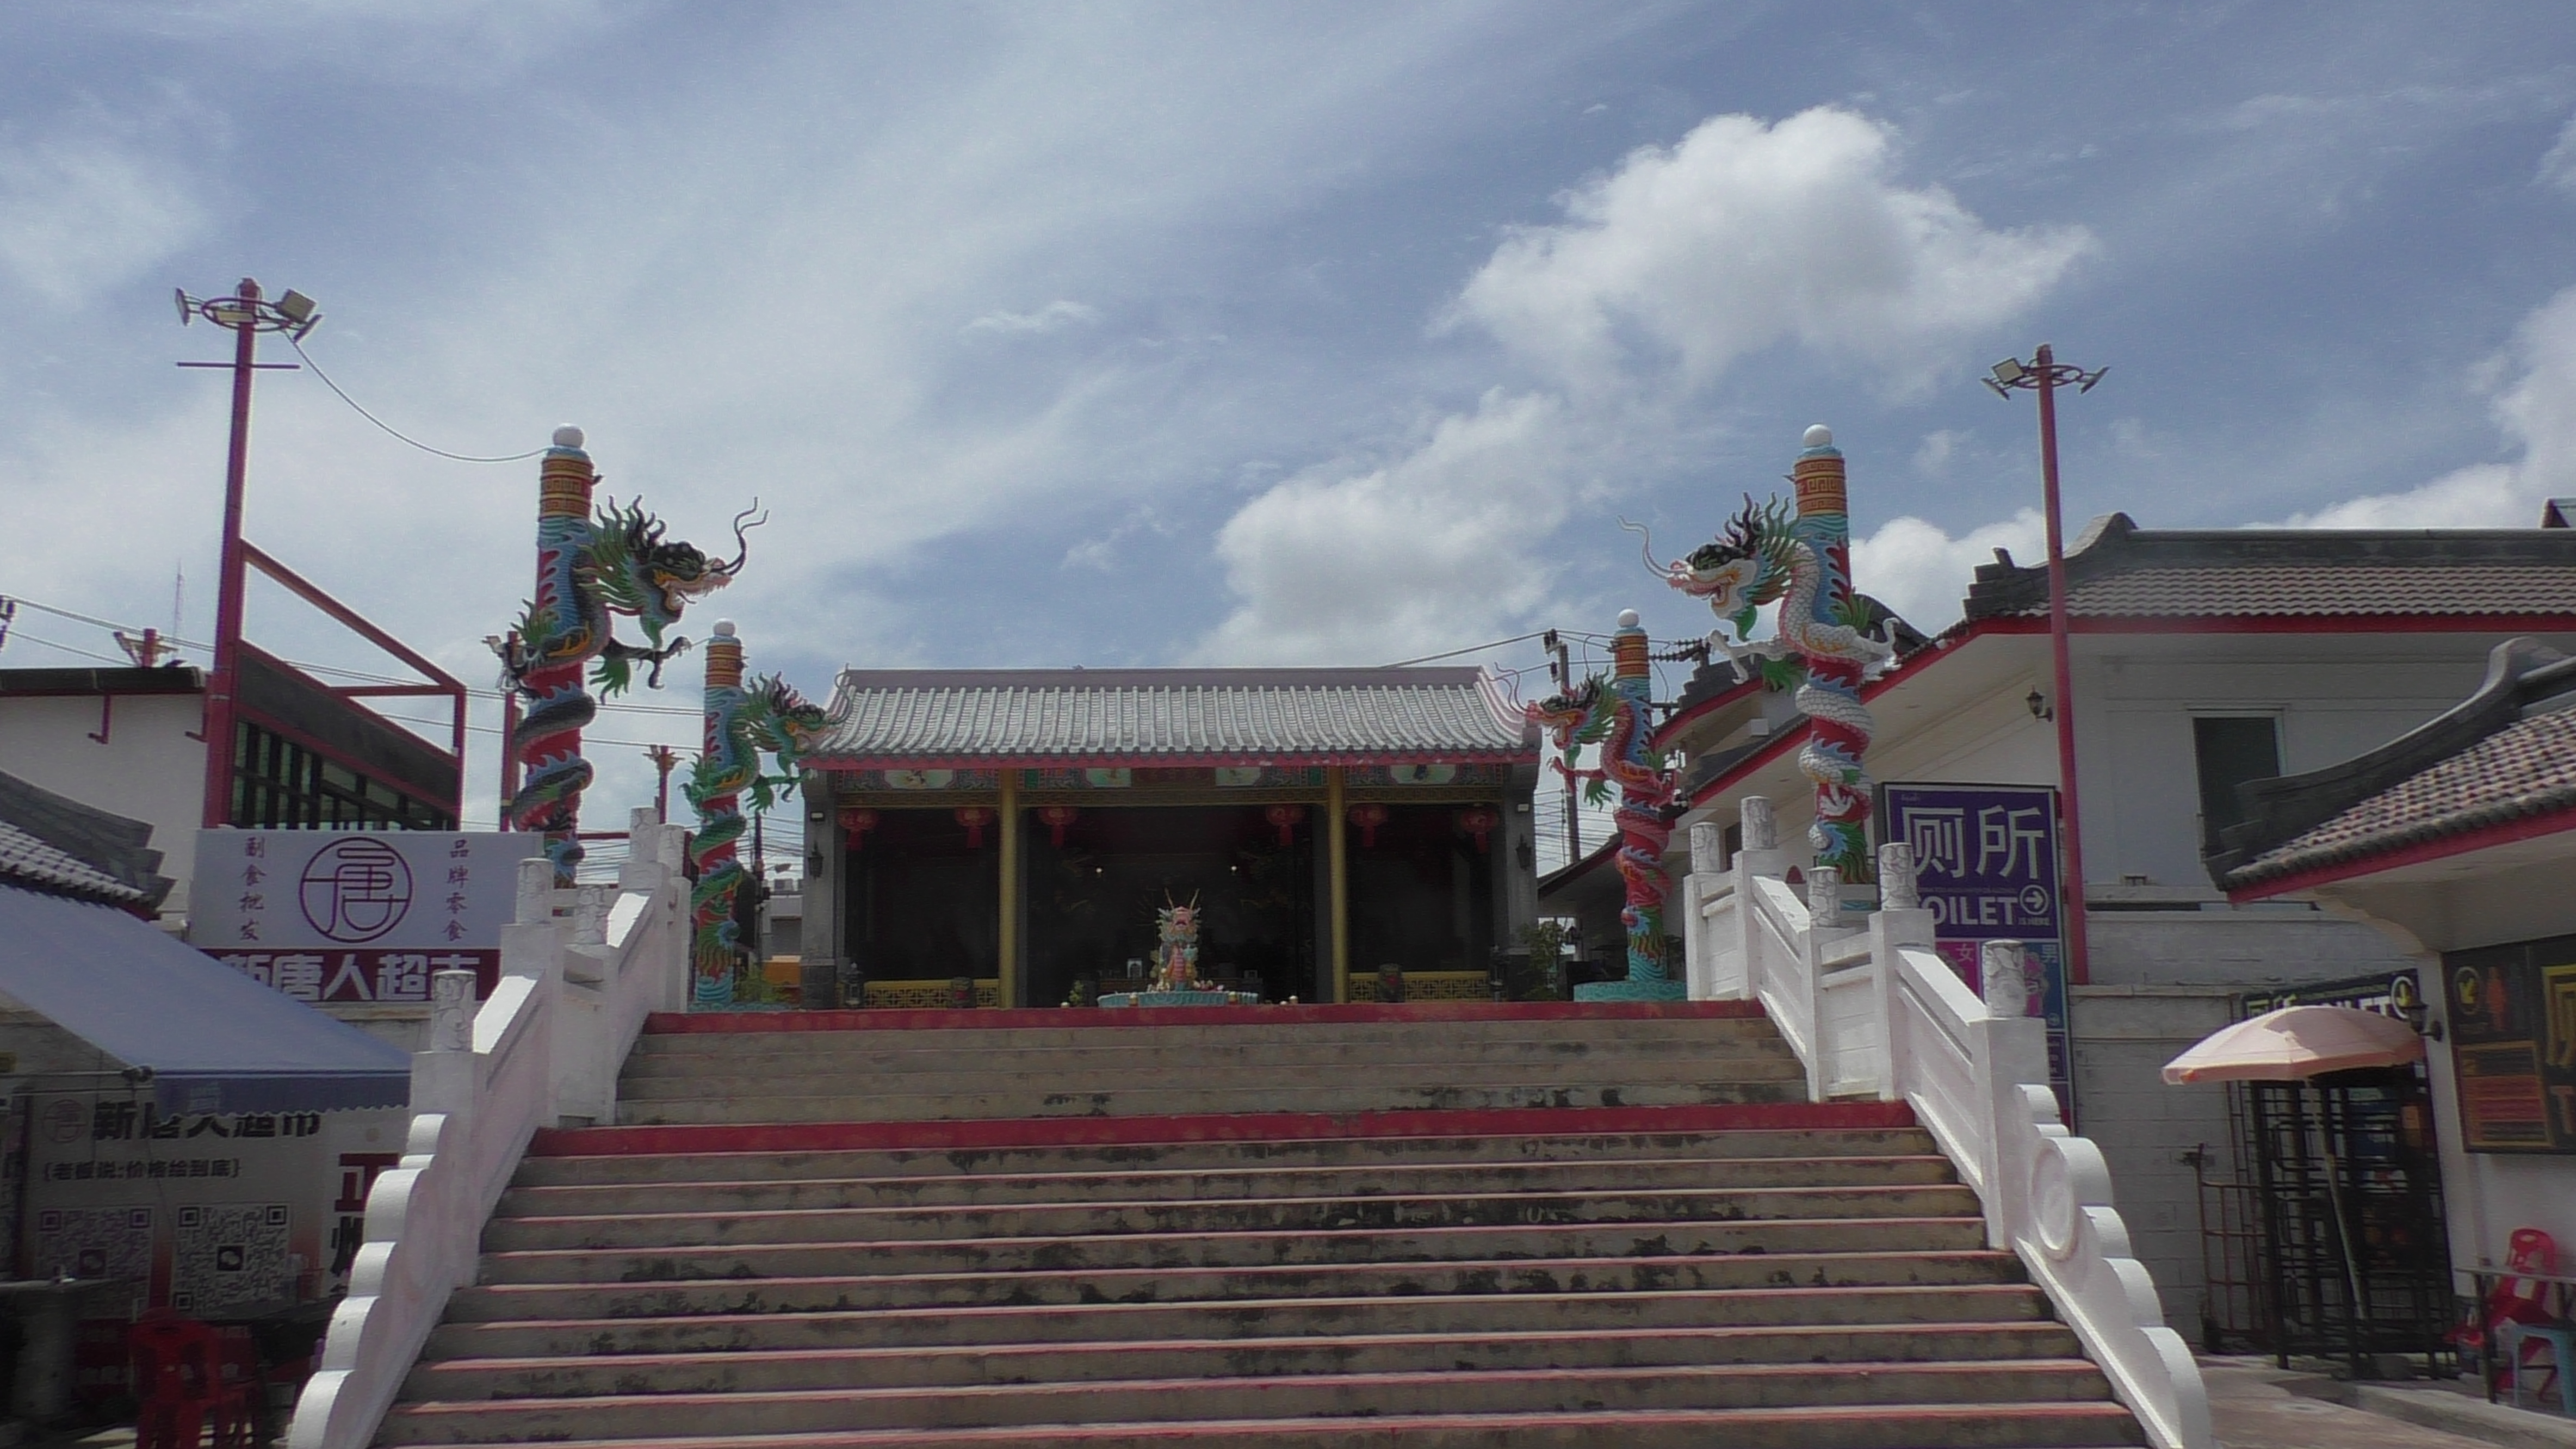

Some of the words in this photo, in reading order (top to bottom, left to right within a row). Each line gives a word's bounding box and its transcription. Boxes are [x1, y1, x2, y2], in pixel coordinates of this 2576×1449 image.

[1902, 805, 2045, 879] 厕所
[239, 836, 267, 942] 副食批发
[443, 839, 470, 942] 品牌零食
[1918, 896, 2018, 925] OILET
[1955, 943, 1975, 962] 女
[2041, 944, 2059, 963] 男
